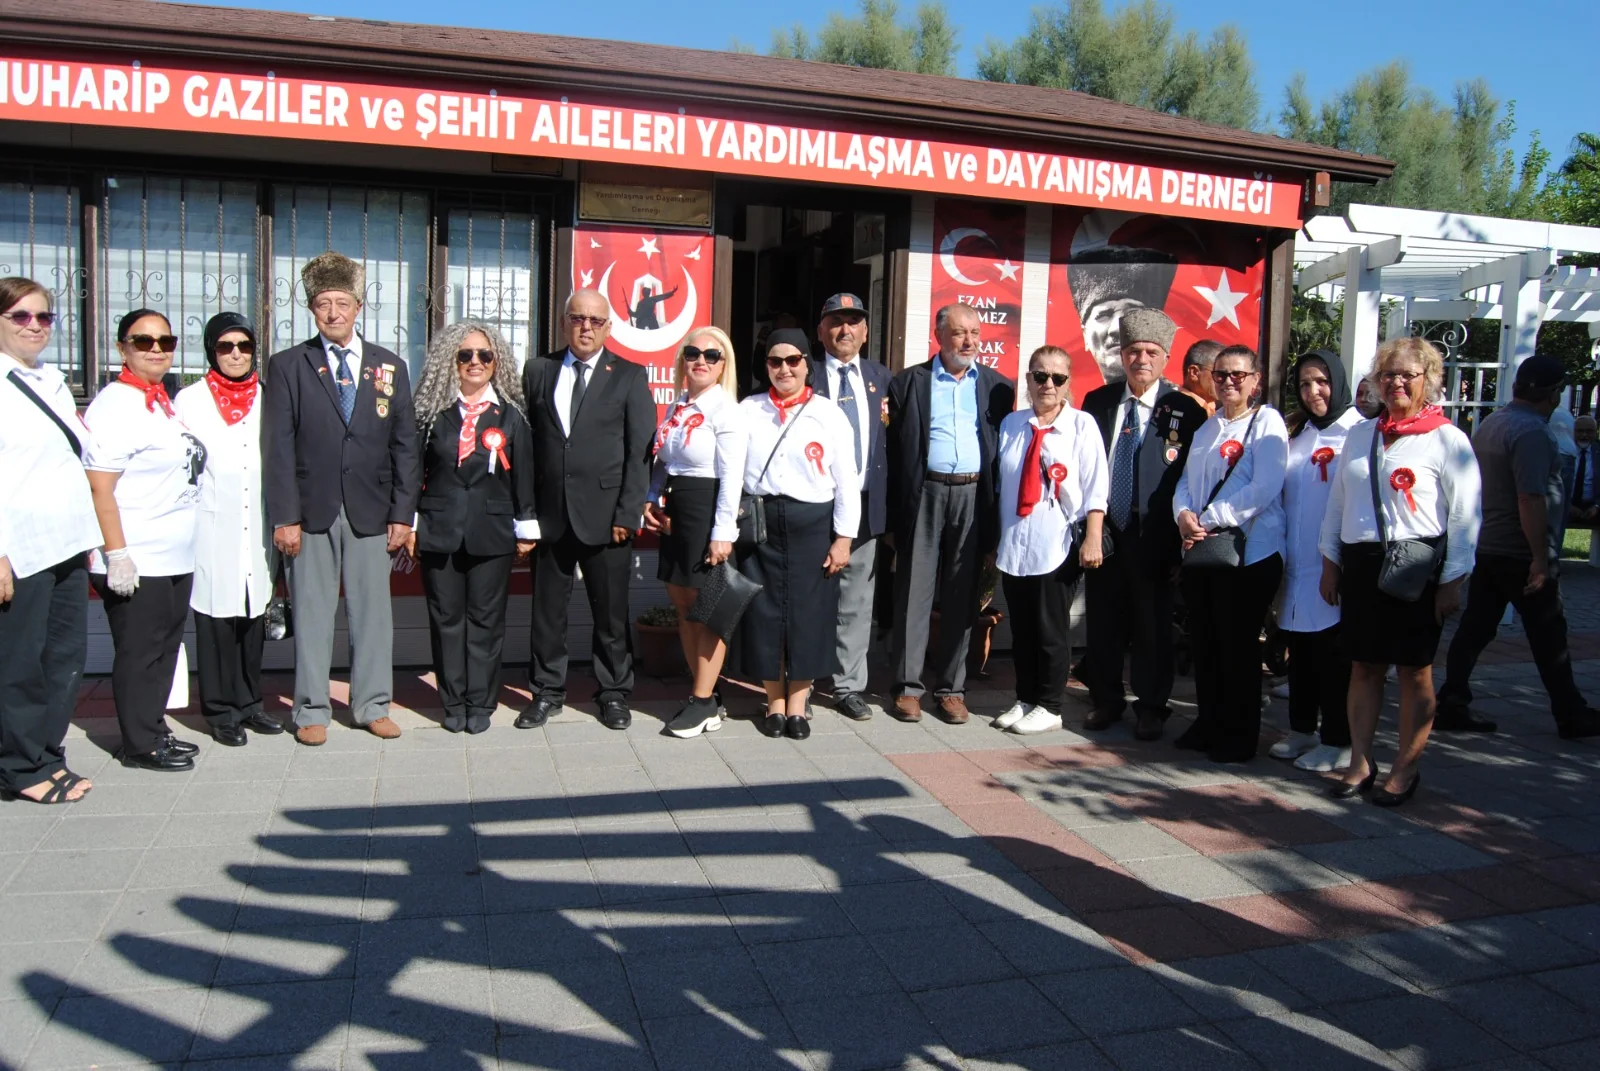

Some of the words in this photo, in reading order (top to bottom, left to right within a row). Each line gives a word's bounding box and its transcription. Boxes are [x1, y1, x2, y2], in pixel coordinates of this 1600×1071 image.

[183, 70, 350, 129] GAZİLER
[360, 95, 405, 132] ve
[415, 88, 524, 141] ŞEHİT
[530, 98, 686, 156] AİLELERİ
[696, 117, 935, 181] YARDIMLAŞMA
[943, 150, 979, 183] ve
[986, 147, 1154, 203] DAYANIŞMA
[1161, 169, 1273, 216] DERNEĞİ
[957, 294, 997, 309] EZAN
[977, 311, 1007, 325] MEZ
[978, 341, 1005, 354] RAK
[645, 362, 676, 383] İLLE
